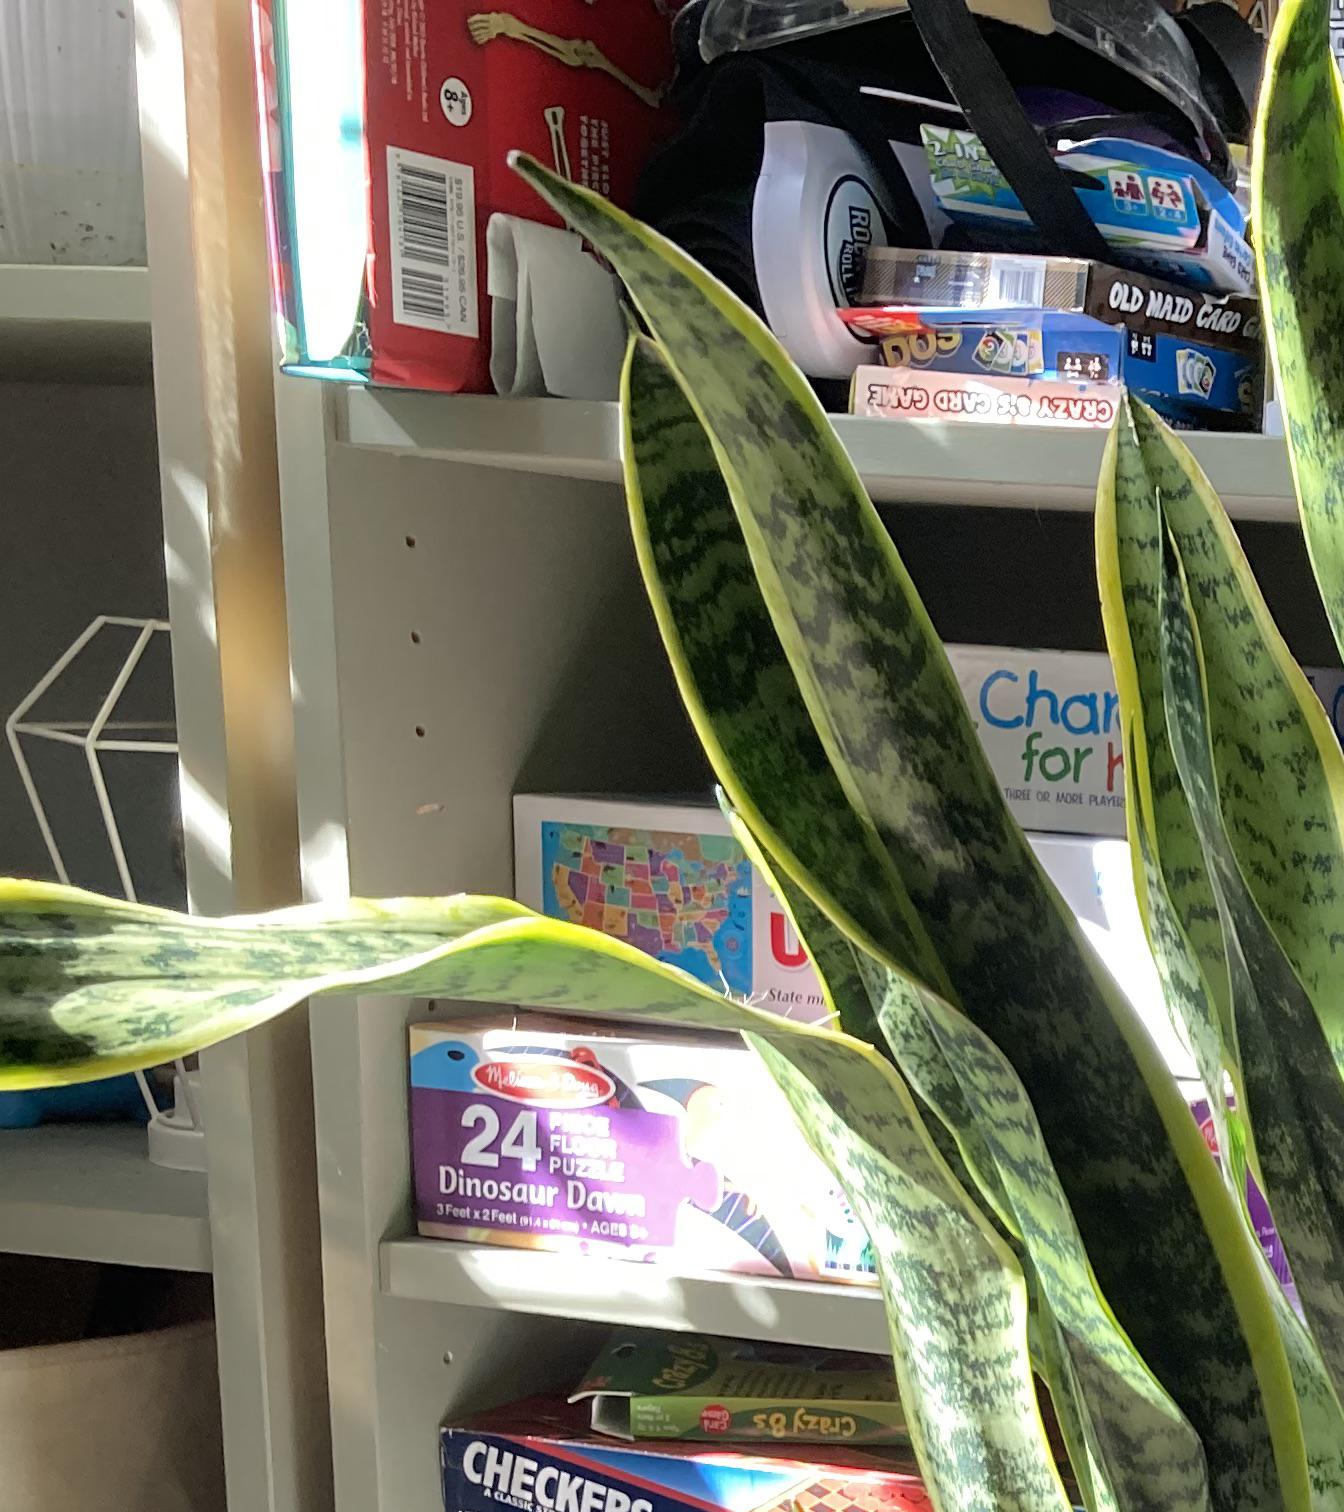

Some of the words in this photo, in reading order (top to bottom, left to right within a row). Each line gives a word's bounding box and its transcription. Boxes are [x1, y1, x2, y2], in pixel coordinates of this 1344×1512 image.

[444, 89, 459, 112] 8+
[592, 154, 600, 191] PIEC
[841, 243, 854, 284] ROLL
[1108, 281, 1144, 313] OLD
[1145, 289, 1194, 323] MAID
[1196, 304, 1241, 333] CARD
[867, 383, 930, 411] GAME
[933, 389, 992, 415] CARD
[1037, 396, 1113, 423] CRAZY
[979, 669, 1120, 735] Char
[1021, 731, 1093, 784] for
[1004, 787, 1032, 801] THREE
[1036, 790, 1050, 802] OR
[1055, 792, 1084, 805] MORE
[769, 988, 803, 1004] State
[460, 1103, 543, 1173] 24
[439, 1165, 559, 1208] Dinosaur
[446, 1205, 470, 1221] Feet
[481, 1209, 490, 1222] 2
[491, 1210, 517, 1226] Feet
[793, 1407, 857, 1437] Crazy
[484, 1488, 492, 1498] A
[494, 1490, 533, 1512] CLASSIC
